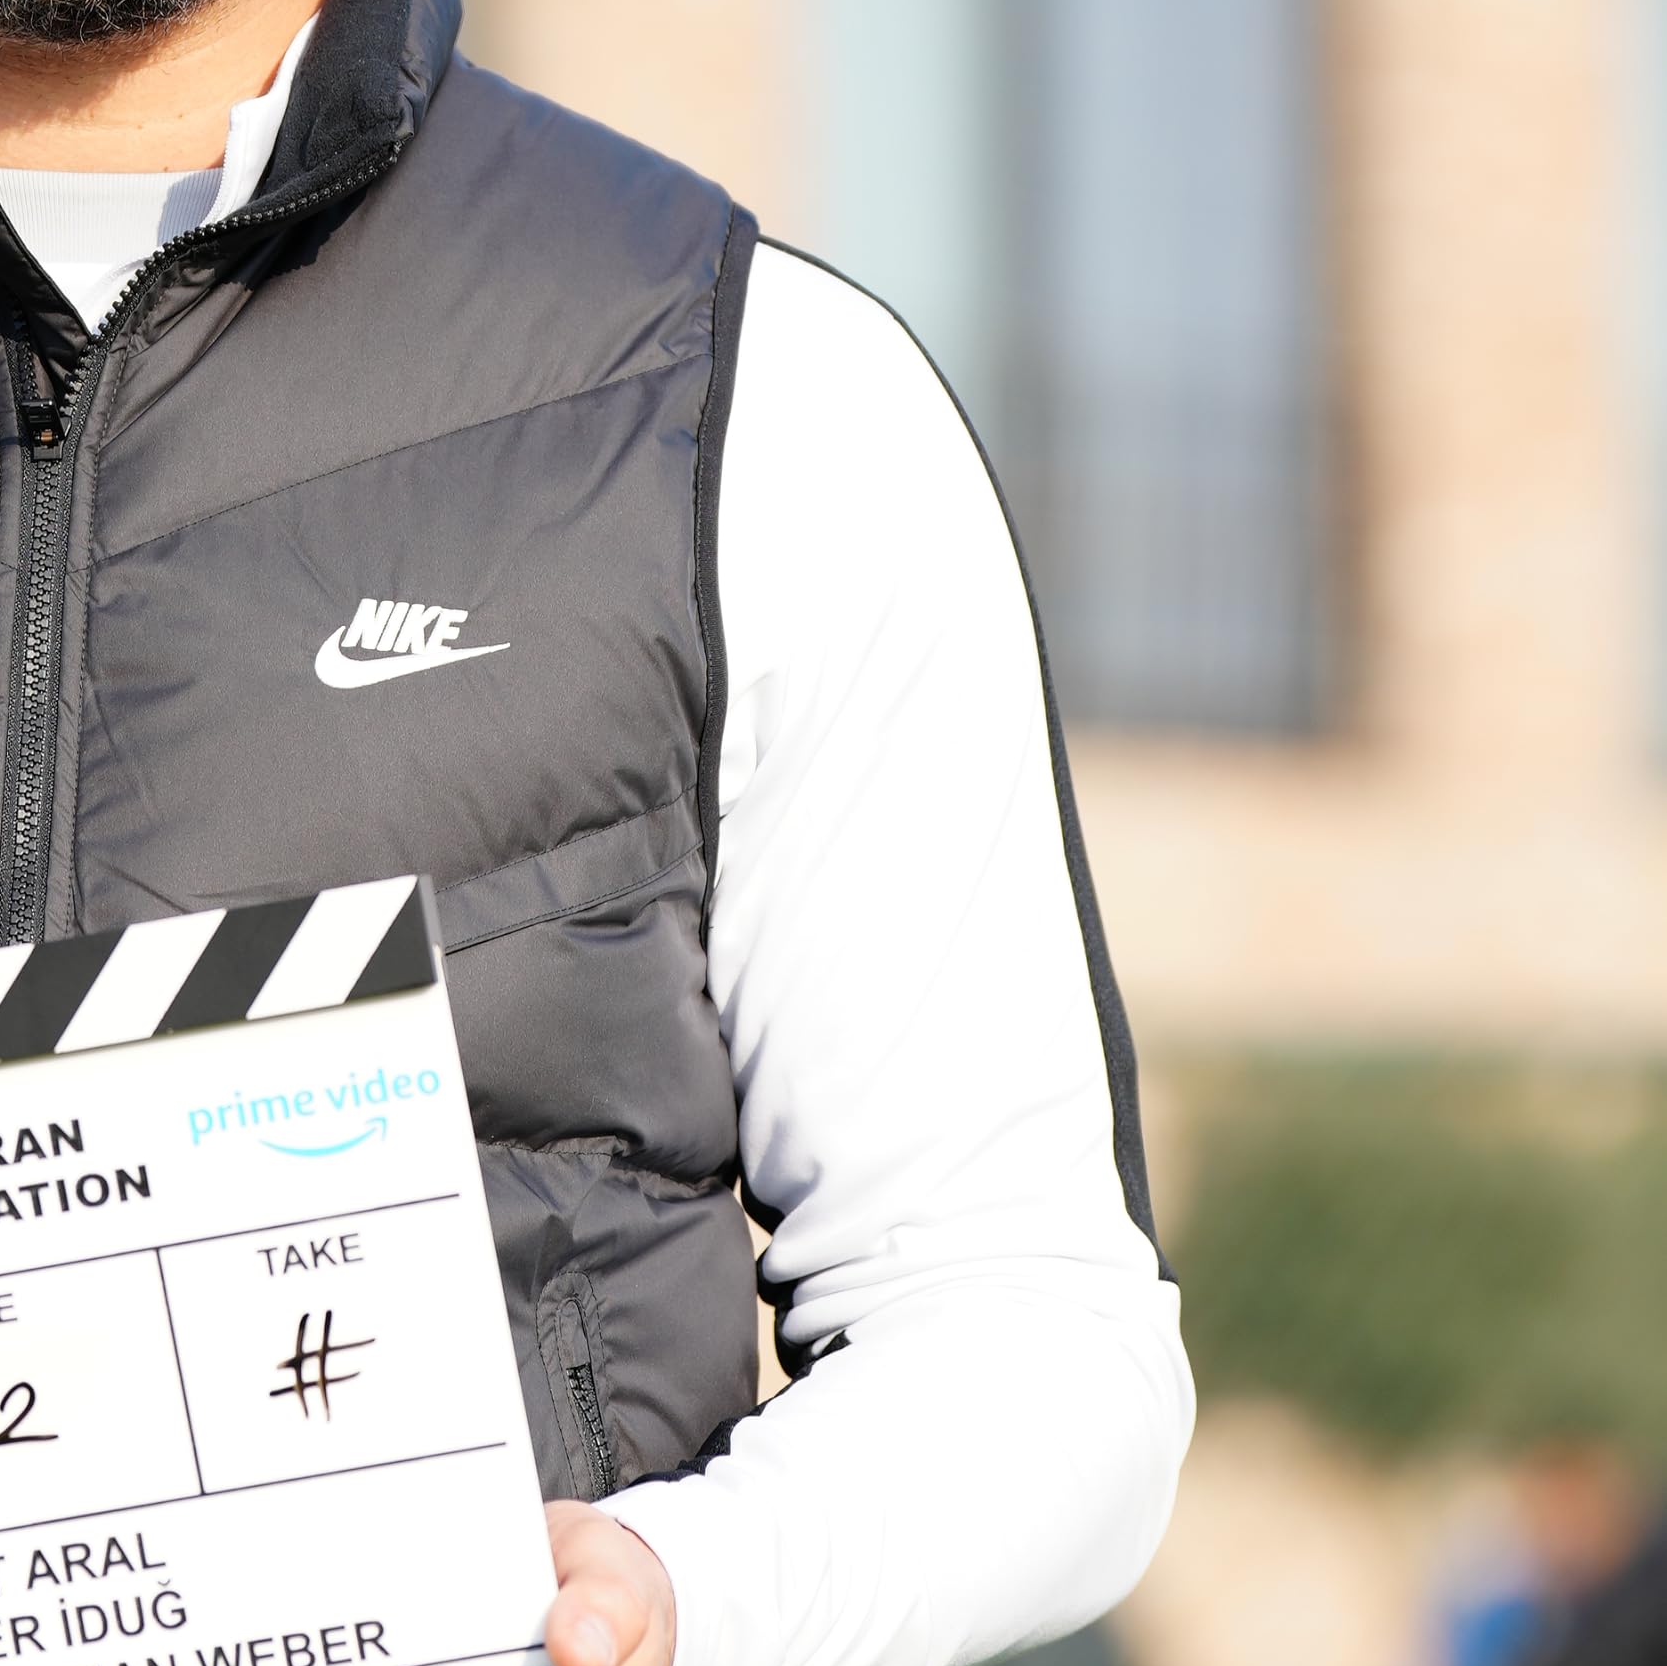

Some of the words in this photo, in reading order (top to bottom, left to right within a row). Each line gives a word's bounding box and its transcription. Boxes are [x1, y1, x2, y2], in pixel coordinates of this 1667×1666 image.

[341, 597, 469, 655] NIKE
[188, 1087, 315, 1146] prime
[327, 1067, 442, 1112] video
[257, 1233, 364, 1277] TAKE
[27, 1532, 167, 1590] ARAL
[60, 1579, 187, 1647] İDUĞ
